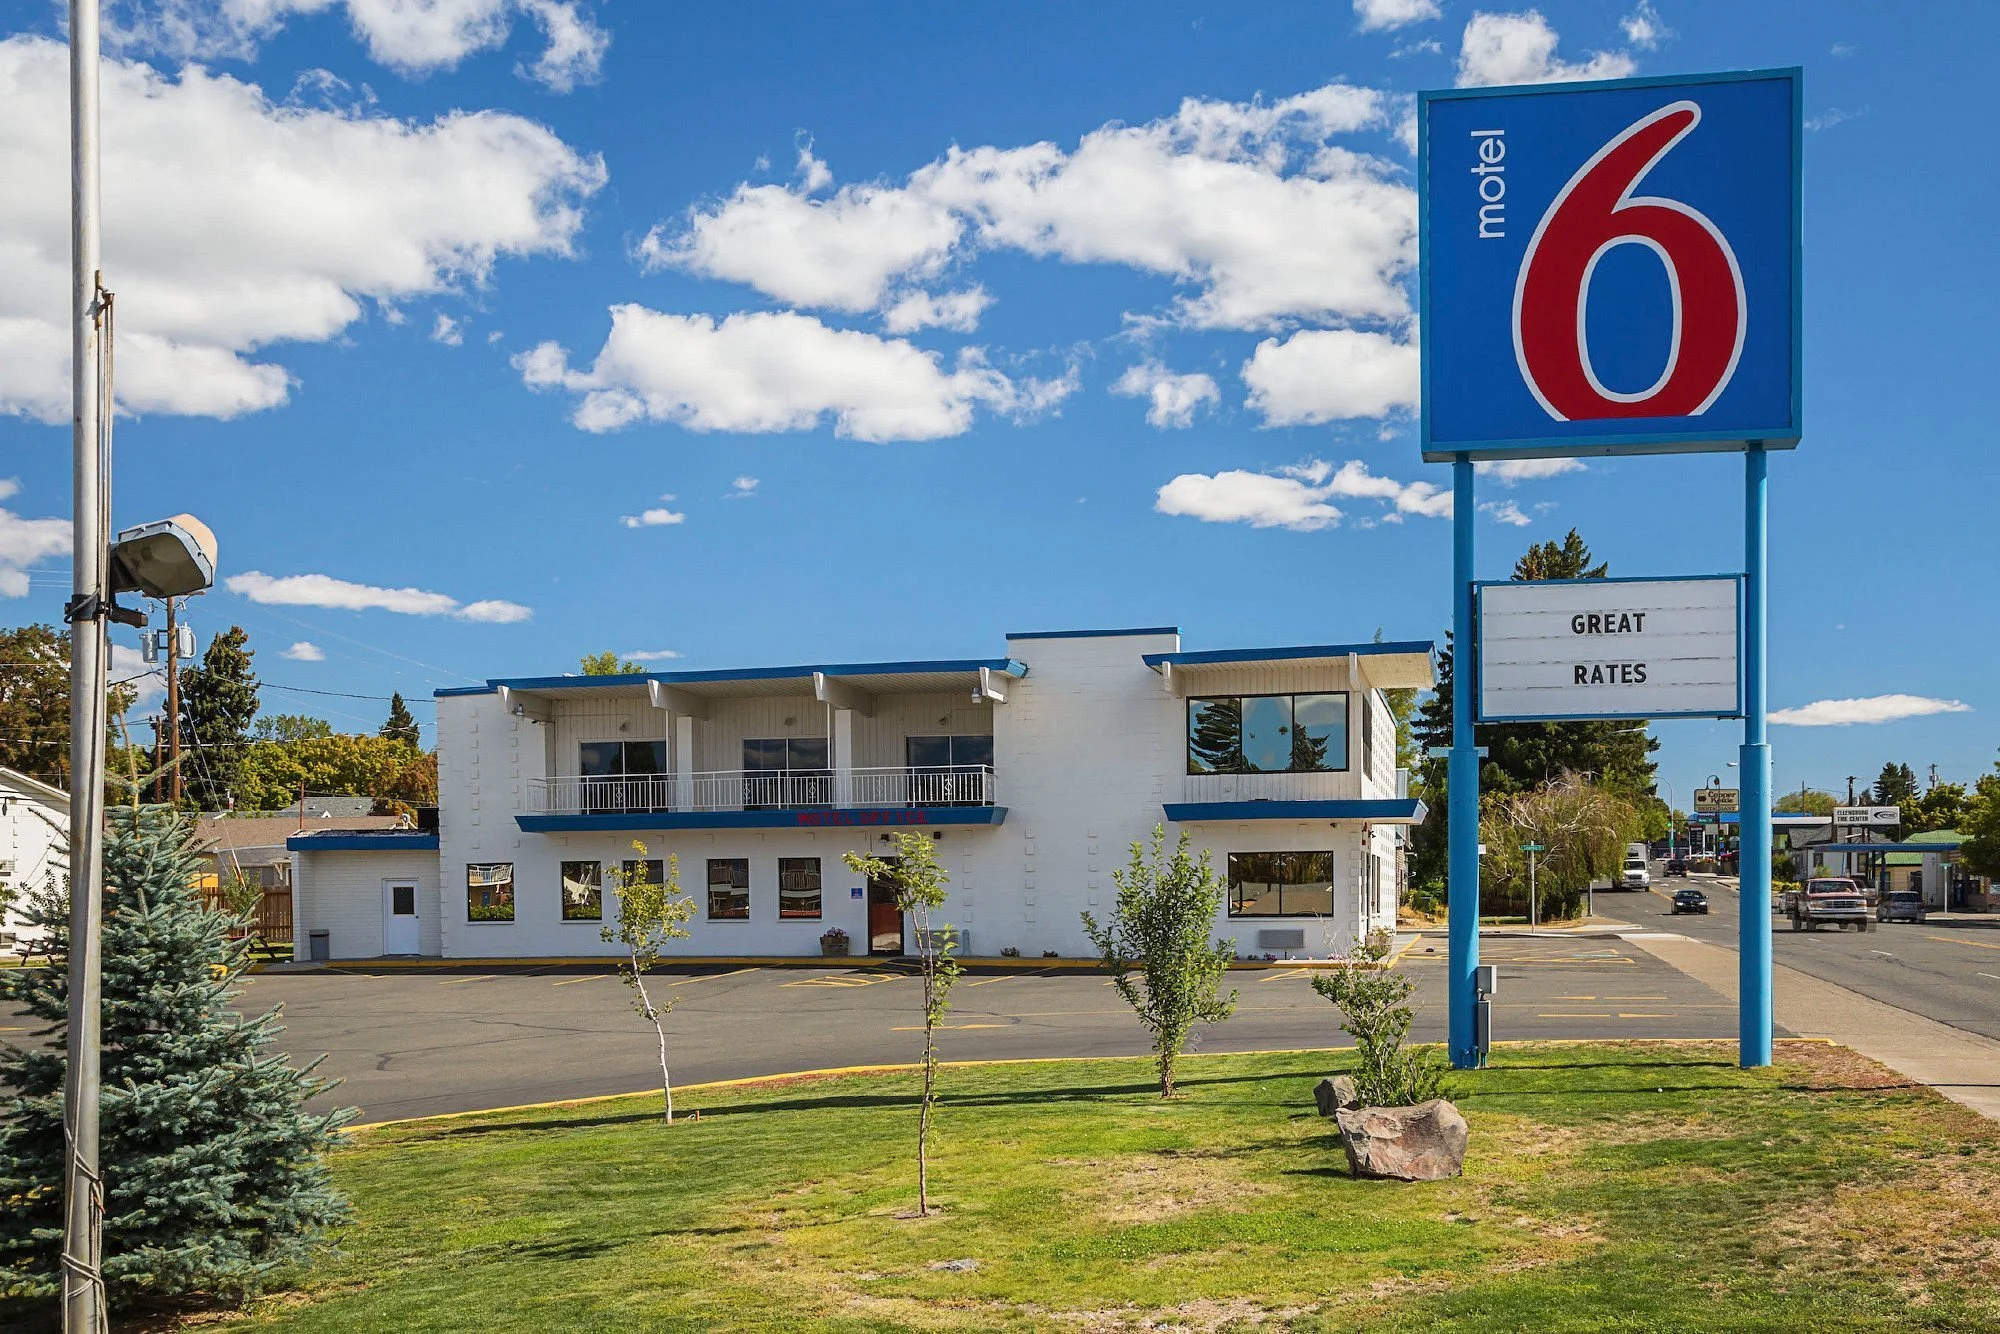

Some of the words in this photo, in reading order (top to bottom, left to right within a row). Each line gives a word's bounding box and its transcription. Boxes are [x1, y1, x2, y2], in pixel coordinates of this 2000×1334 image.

[1470, 130, 1506, 238] motel
[1511, 99, 1747, 422] 6
[1571, 612, 1646, 635] GREAT
[1574, 663, 1647, 684] RATES
[797, 812, 855, 827] MOTEL
[859, 810, 929, 826] OFFICE
